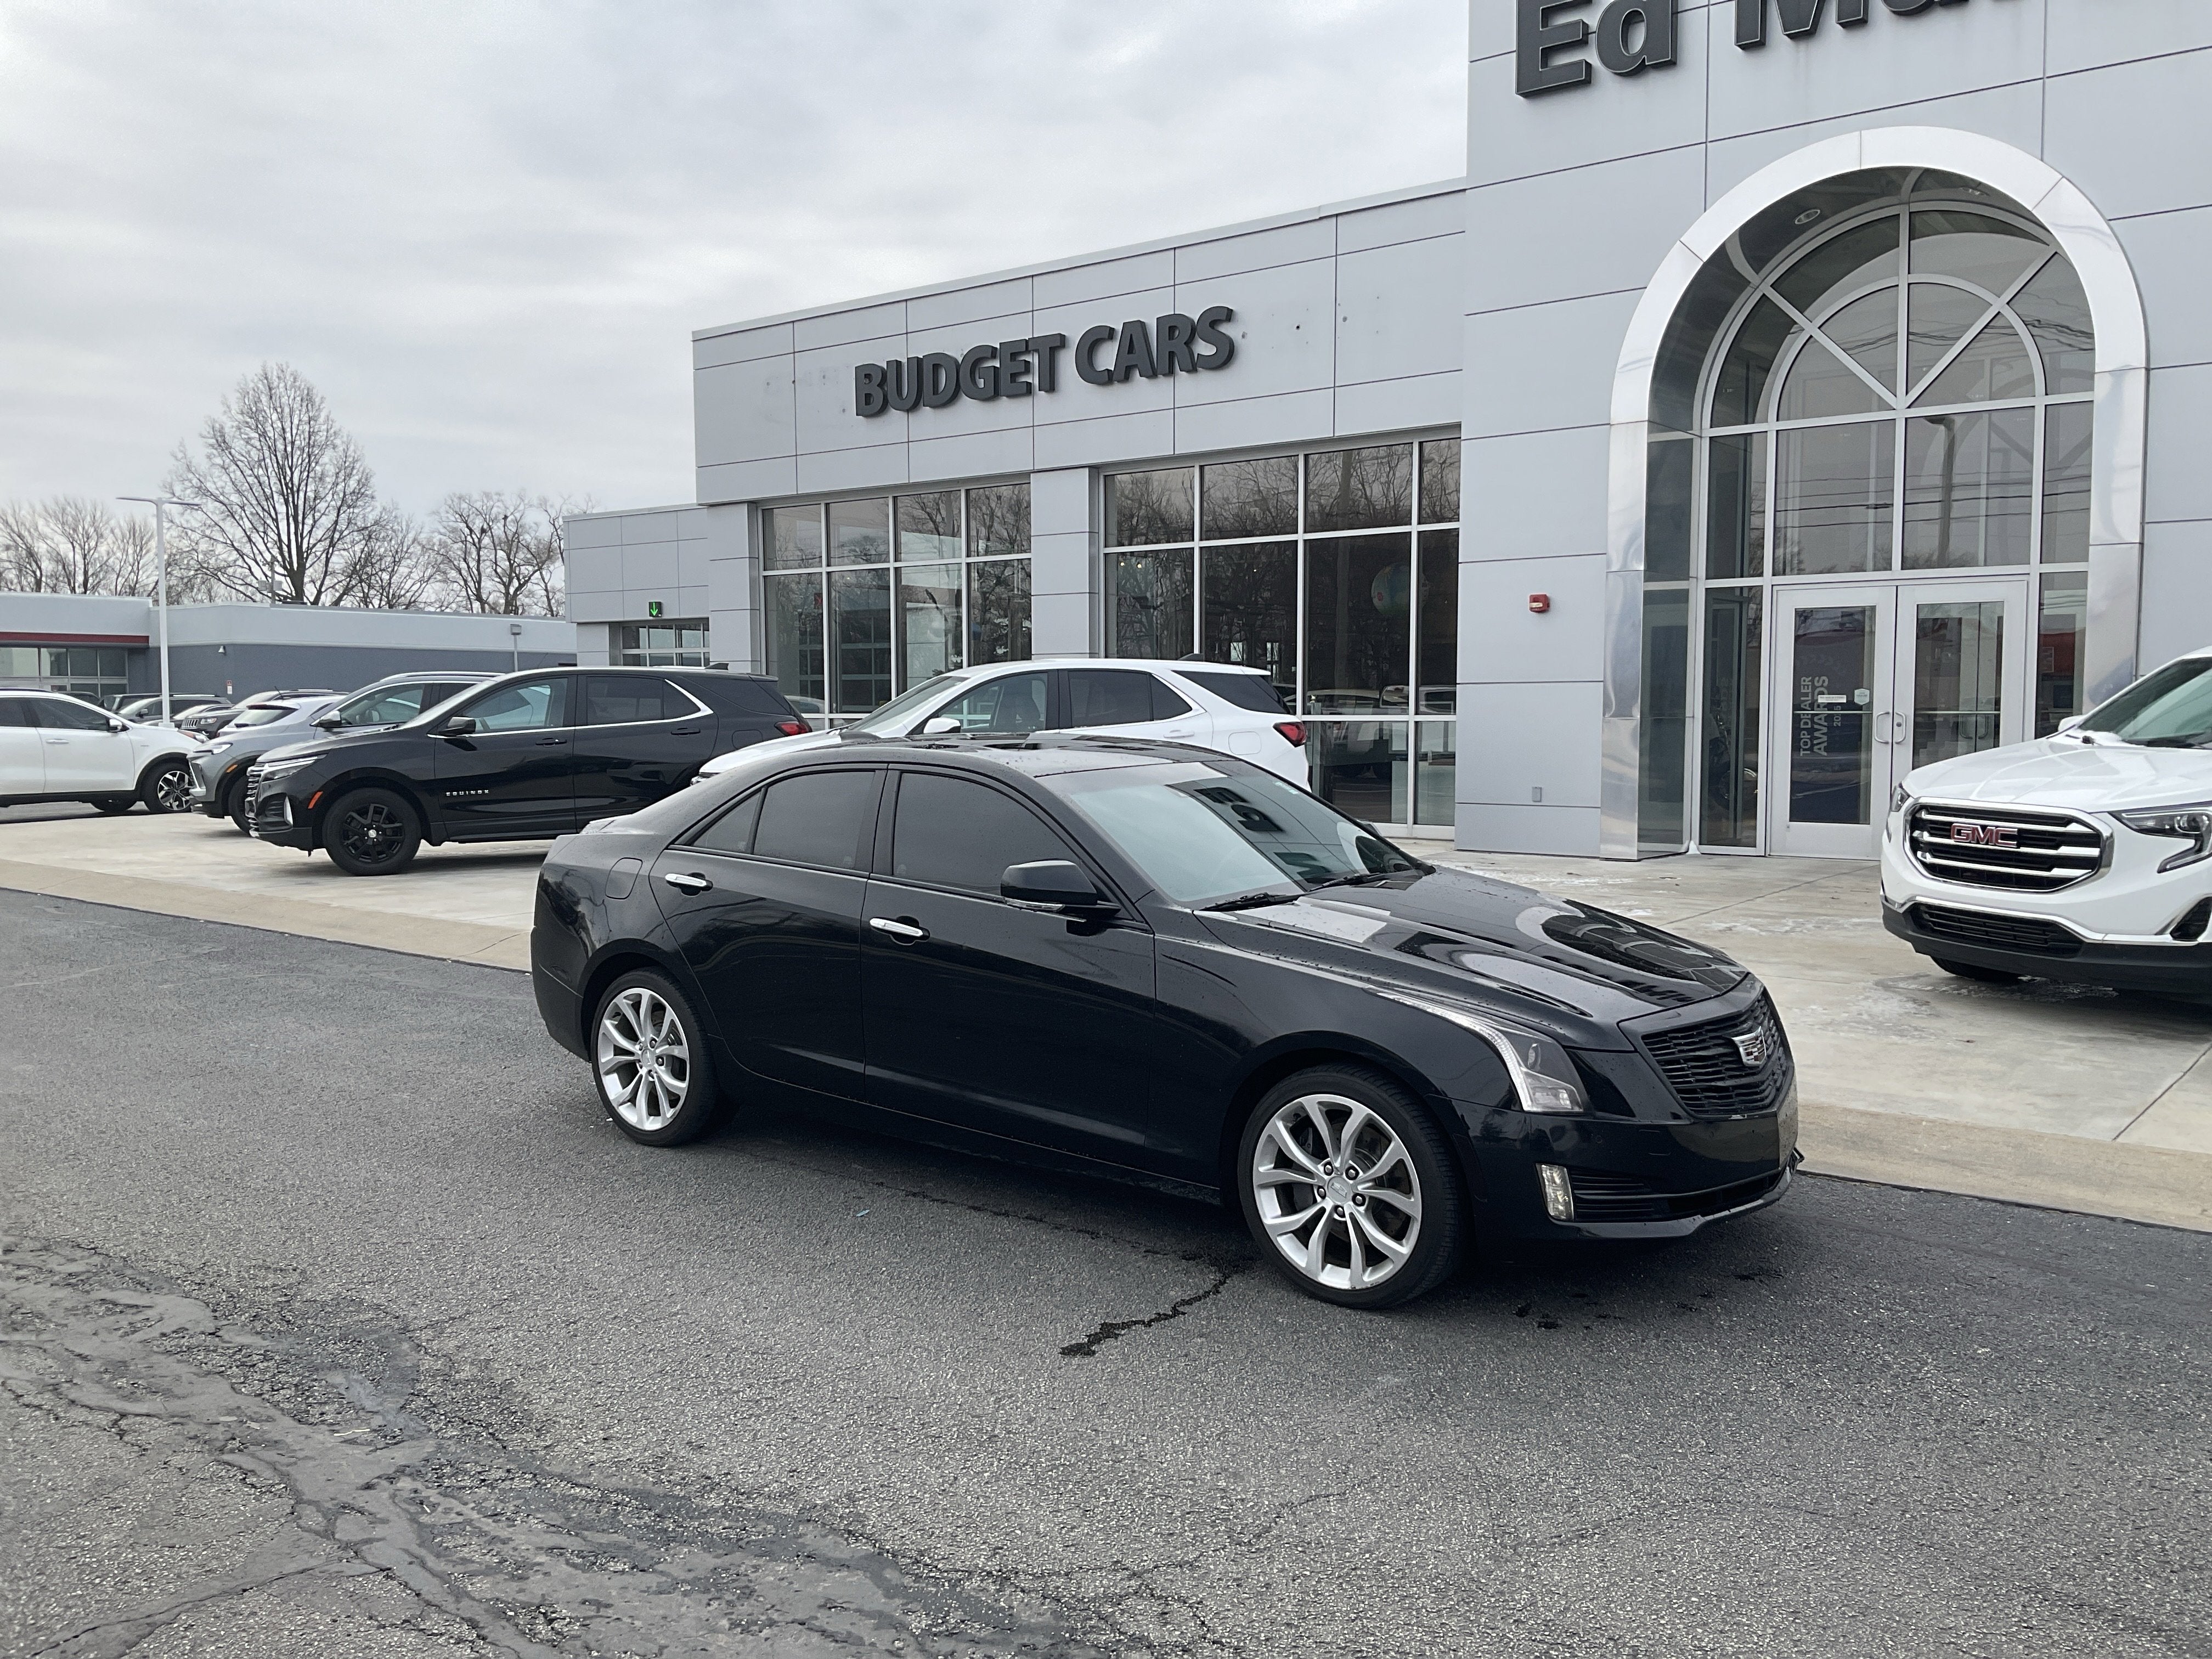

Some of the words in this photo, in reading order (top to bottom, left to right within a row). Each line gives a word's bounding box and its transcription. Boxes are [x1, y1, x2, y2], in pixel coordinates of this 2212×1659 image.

[855, 332, 1065, 417] BUDGET
[1075, 306, 1235, 385] CARS
[1800, 676, 1812, 729] DEALER
[1813, 676, 1829, 757] AWARDS
[1800, 730, 1811, 757] TOP
[1950, 823, 2018, 848] GMC
